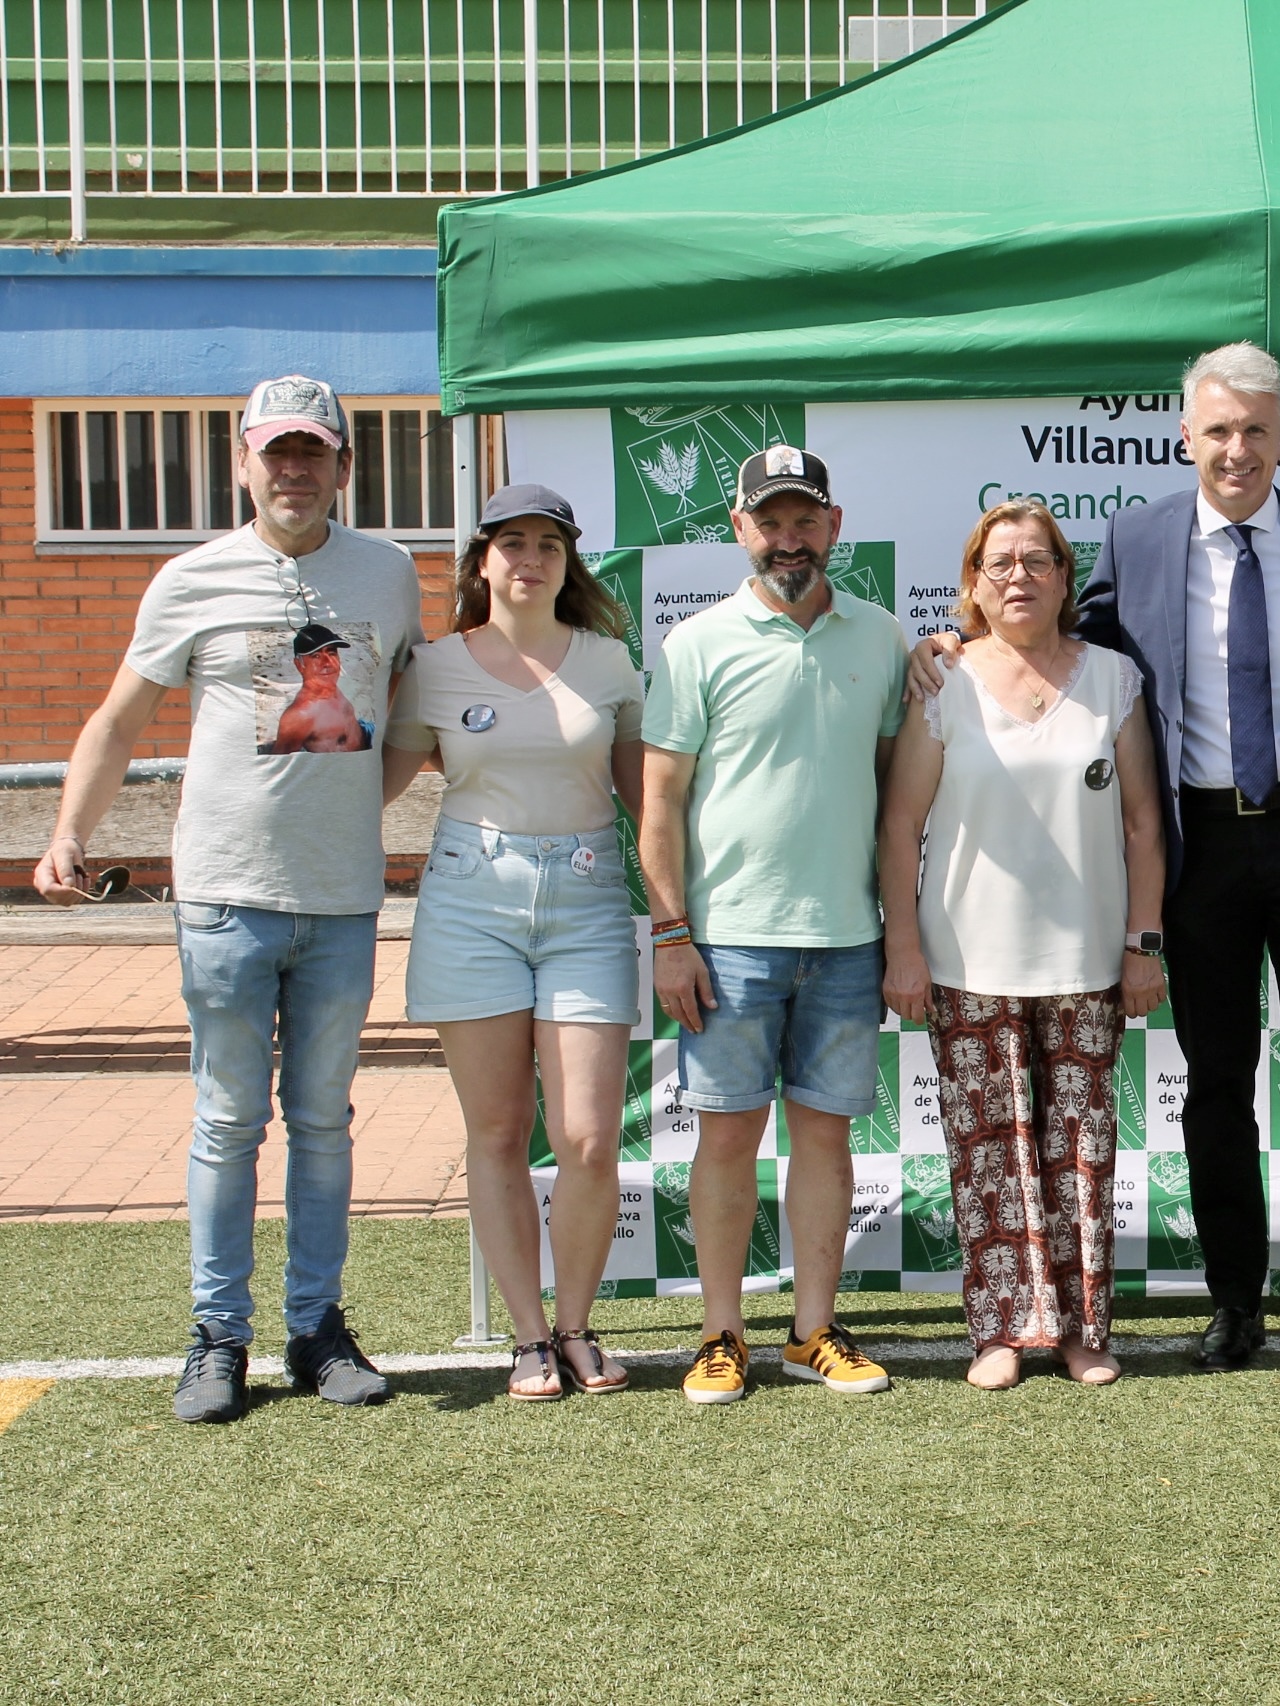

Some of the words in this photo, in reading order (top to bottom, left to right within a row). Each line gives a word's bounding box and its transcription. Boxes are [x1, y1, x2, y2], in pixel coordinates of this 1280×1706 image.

[1021, 425, 1196, 466] Villanue
[654, 591, 736, 607] Ayuntamie
[655, 612, 674, 625] de
[910, 606, 928, 618] de
[917, 624, 939, 636] del
[573, 861, 593, 874] ELIAS
[1122, 1081, 1135, 1103] PLENA
[1158, 1093, 1176, 1104] de
[665, 1101, 683, 1114] de
[915, 1095, 932, 1107] de
[1131, 1104, 1146, 1130] GRATIA
[1166, 1111, 1182, 1123] de
[671, 1120, 694, 1132] del
